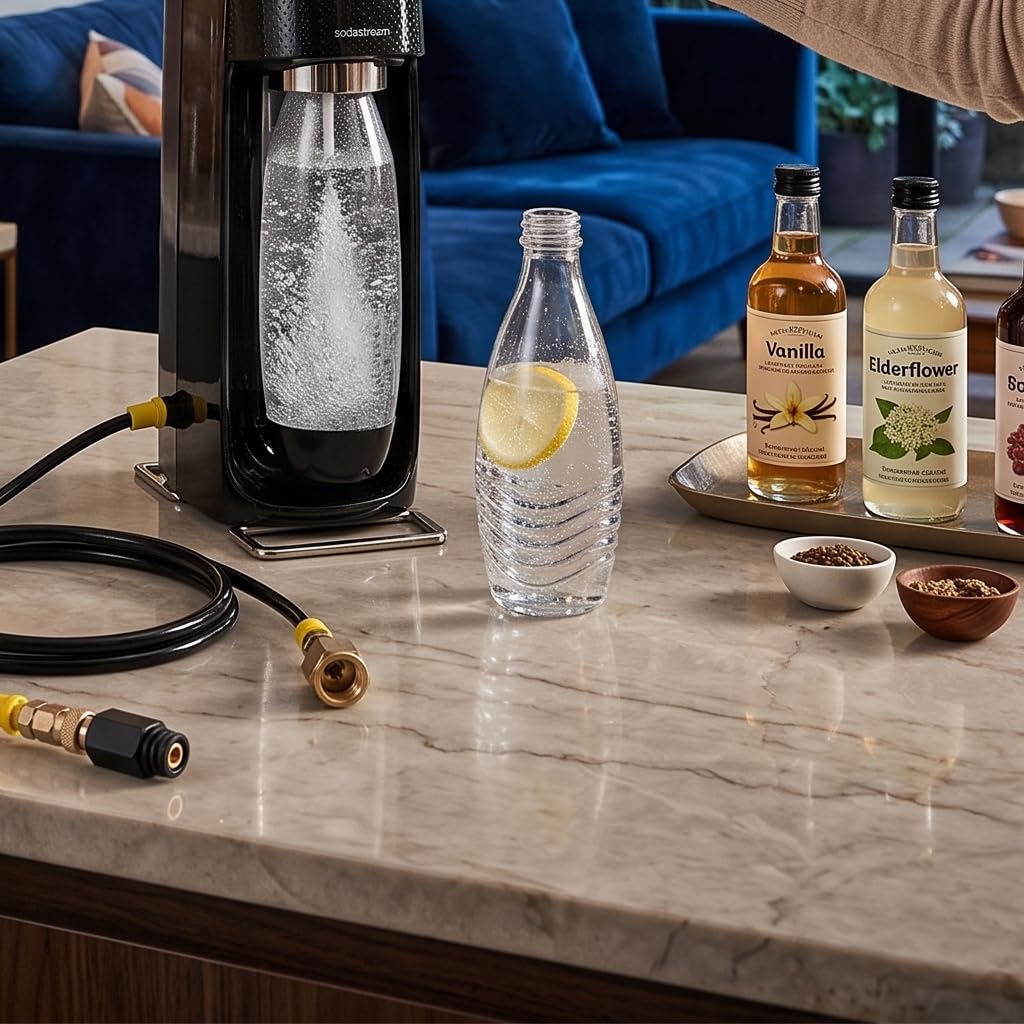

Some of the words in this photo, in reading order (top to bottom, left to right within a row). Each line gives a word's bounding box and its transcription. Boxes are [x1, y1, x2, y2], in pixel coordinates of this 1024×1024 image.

[334, 27, 391, 38] sodastream
[765, 340, 826, 359] Vanilla
[869, 355, 959, 378] Elderflower
